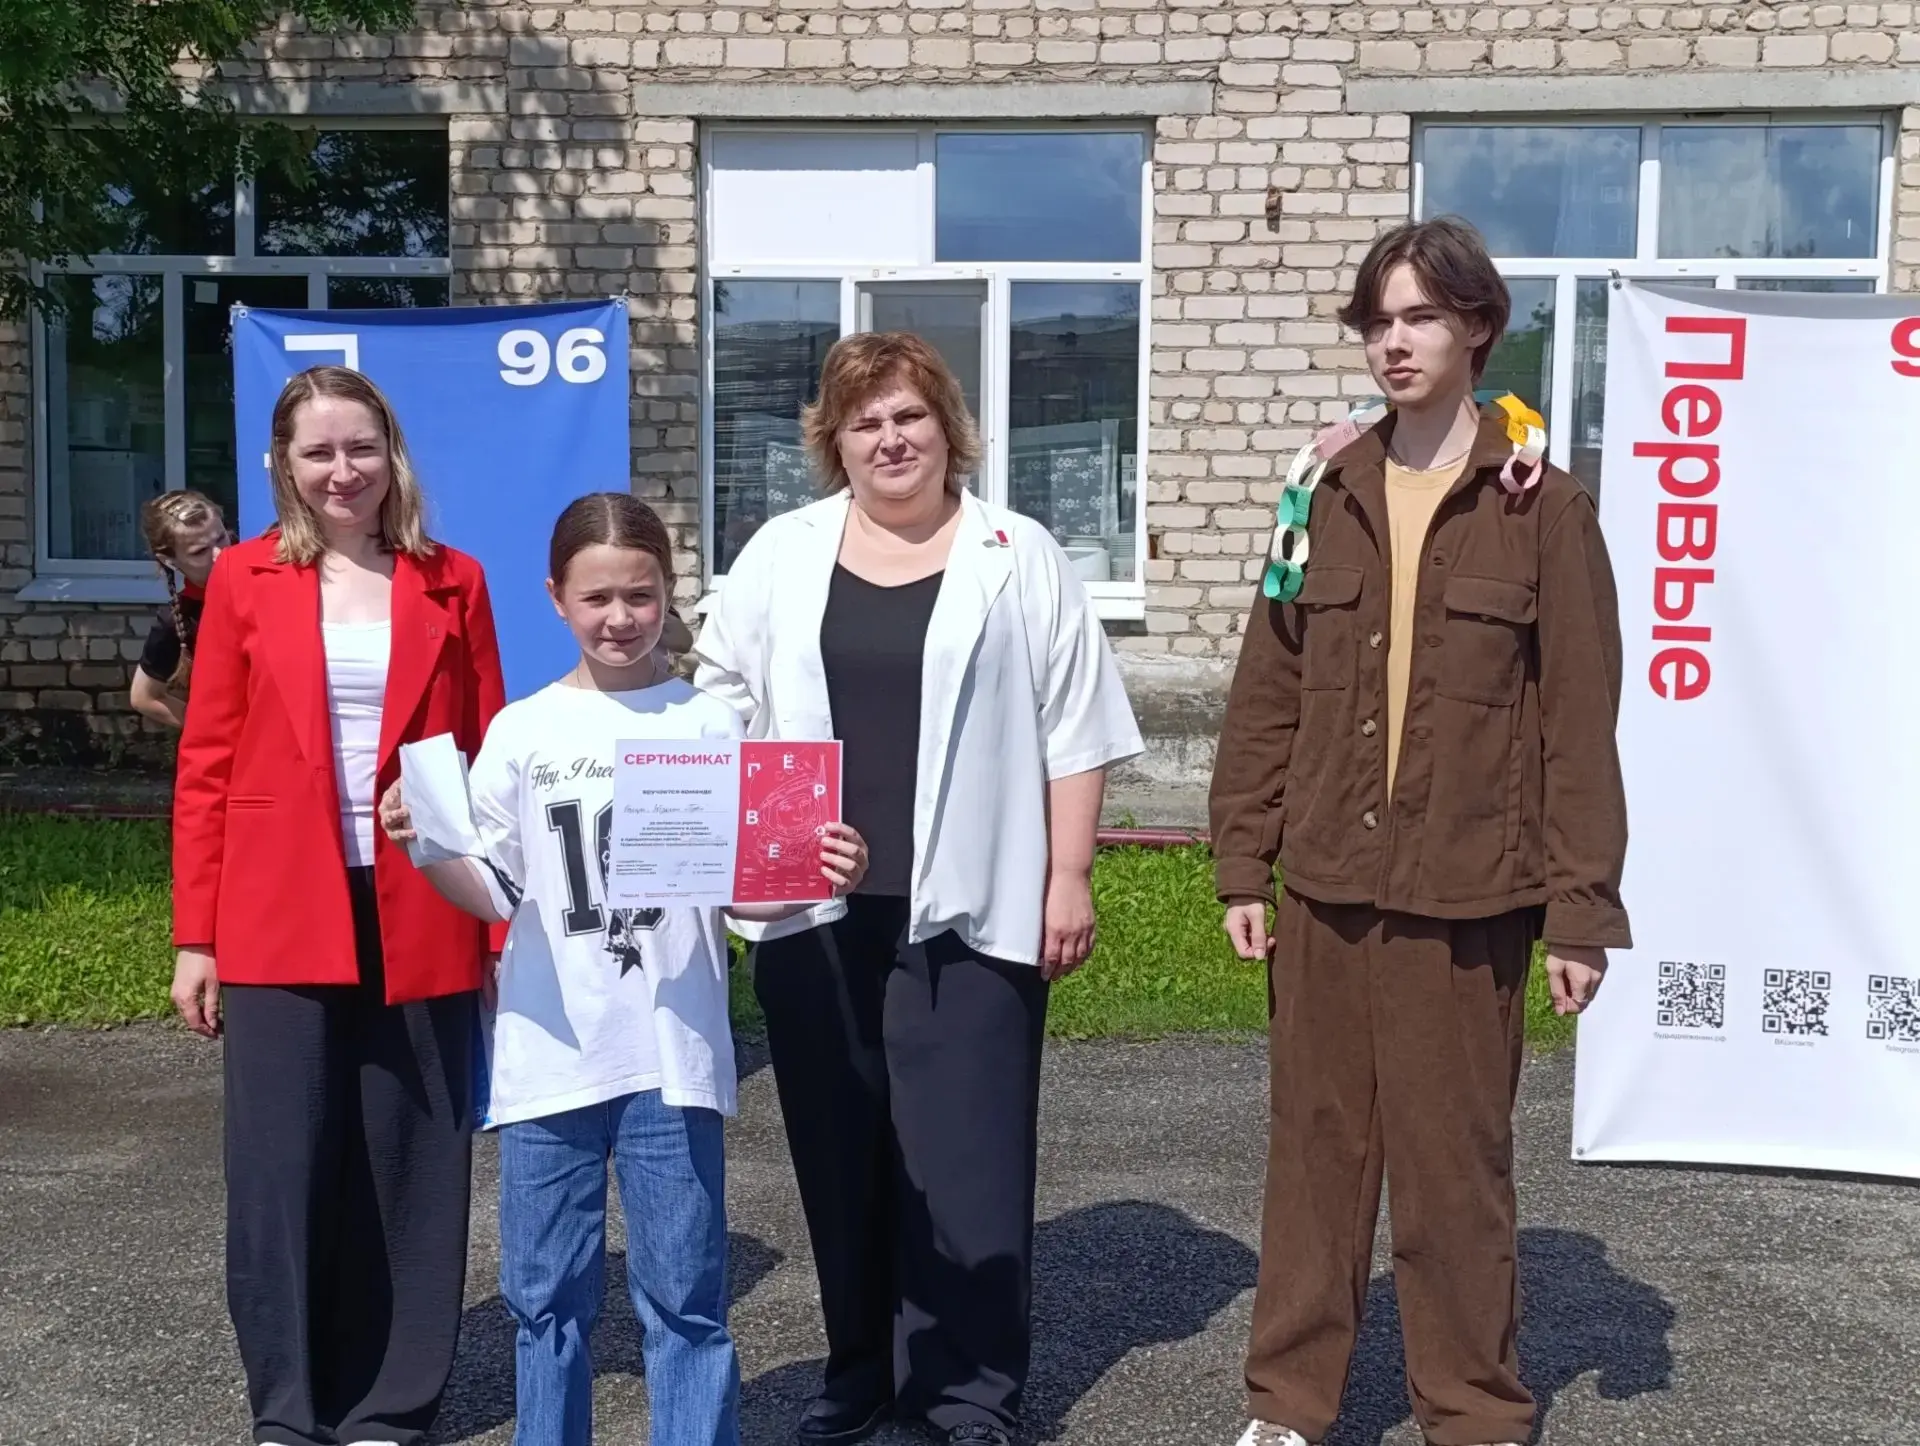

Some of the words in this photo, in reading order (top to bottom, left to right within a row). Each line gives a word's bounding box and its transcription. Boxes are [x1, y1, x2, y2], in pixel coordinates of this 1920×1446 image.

[497, 327, 607, 386] 96
[1633, 316, 1747, 701] Первые
[564, 757, 588, 780] I
[624, 753, 732, 766] СЕРТИФИКАТ
